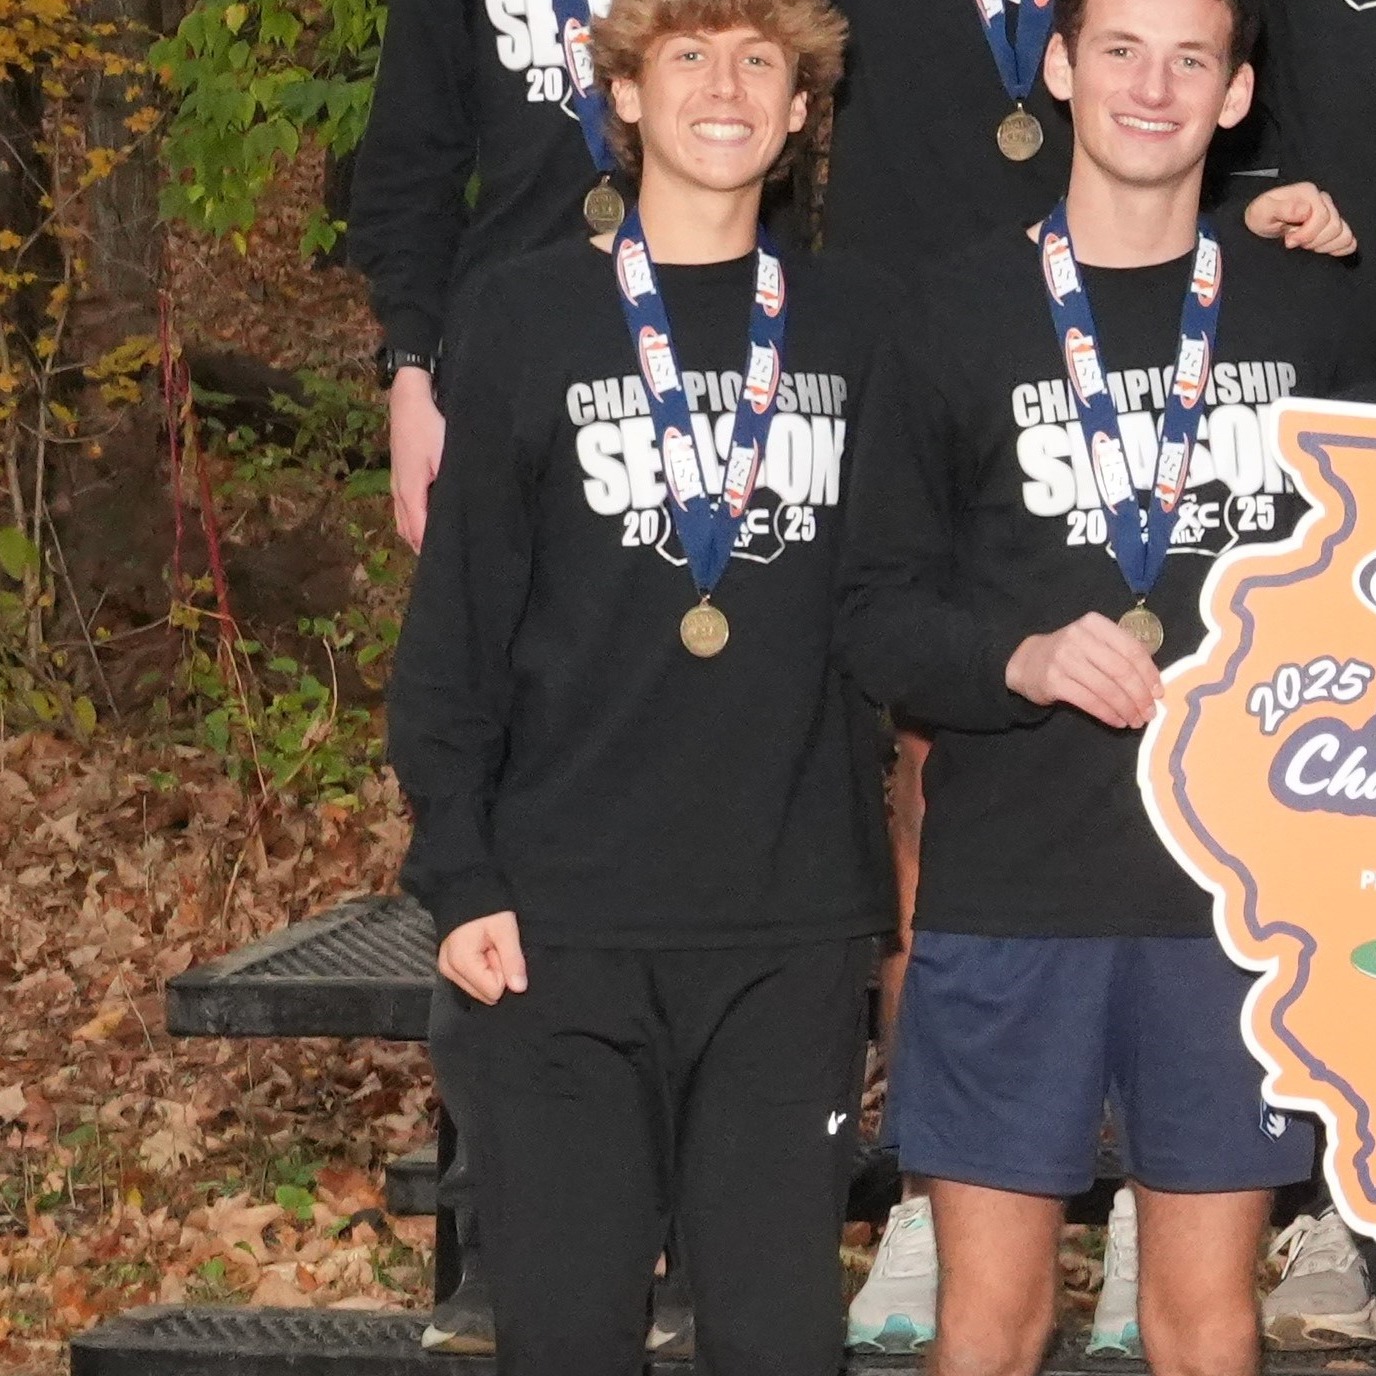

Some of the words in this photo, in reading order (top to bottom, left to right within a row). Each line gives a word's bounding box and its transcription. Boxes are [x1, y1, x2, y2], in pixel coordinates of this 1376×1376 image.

[526, 68, 562, 102] 20
[622, 508, 659, 547] 20
[784, 506, 817, 542] 25
[1067, 508, 1107, 545] 20
[1237, 495, 1275, 531] 25
[1251, 660, 1370, 733] 2025
